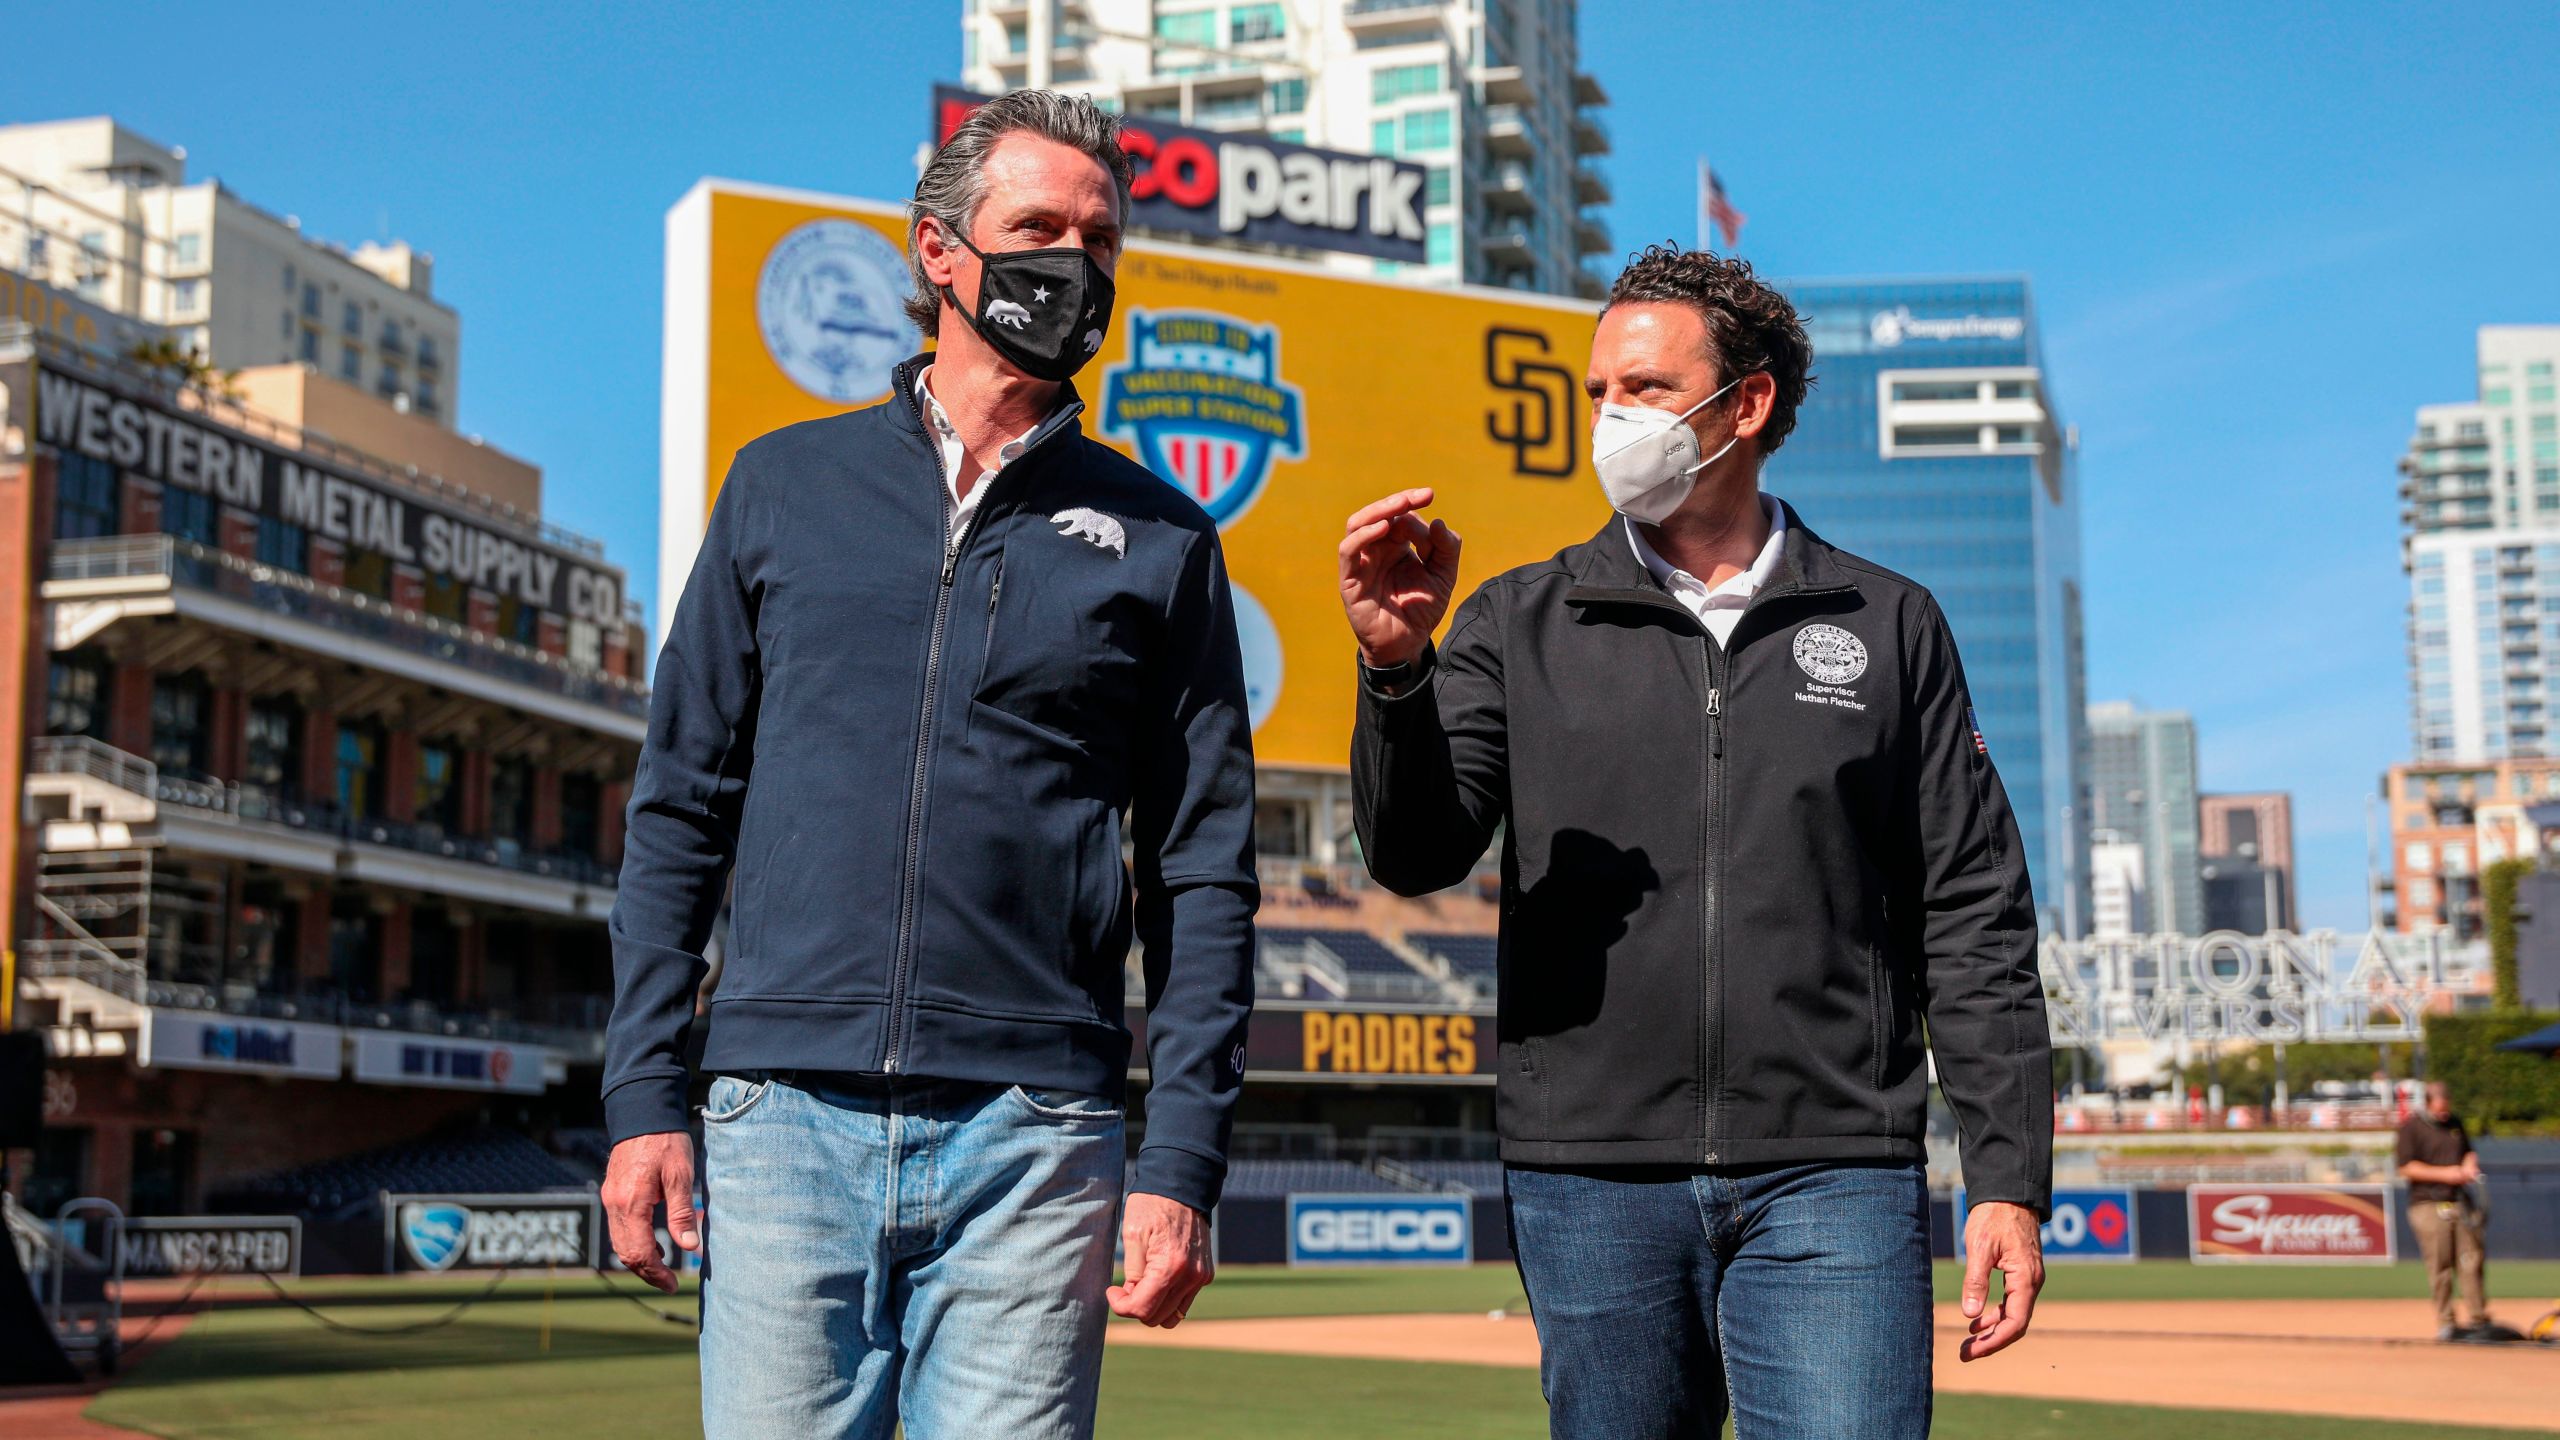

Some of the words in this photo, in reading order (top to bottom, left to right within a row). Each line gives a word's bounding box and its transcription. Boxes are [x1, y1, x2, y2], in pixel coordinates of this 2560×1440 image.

[1219, 141, 1424, 241] park
[1123, 370, 1284, 412] VACCINATION
[1486, 326, 1576, 479] SD
[1117, 397, 1193, 420] SUPER
[1198, 399, 1289, 437] STATION
[38, 370, 264, 512] WESTERN
[280, 460, 415, 562] METAL
[421, 514, 560, 607] SUPPLY
[567, 566, 625, 634] CO.
[1794, 692, 1828, 704] Nathan
[1830, 696, 1867, 711] Fletcher
[1806, 682, 1857, 698] Supervisor
[2040, 927, 2476, 1000] ATIONAL
[2047, 993, 2430, 1044] NIVERSITY
[1303, 1010, 1477, 1074] PADRES
[471, 1210, 582, 1235] ROCKET
[1298, 1210, 1464, 1252] GEICO
[2211, 1195, 2366, 1254] Sycuan
[122, 1230, 289, 1272] MANSCAPED
